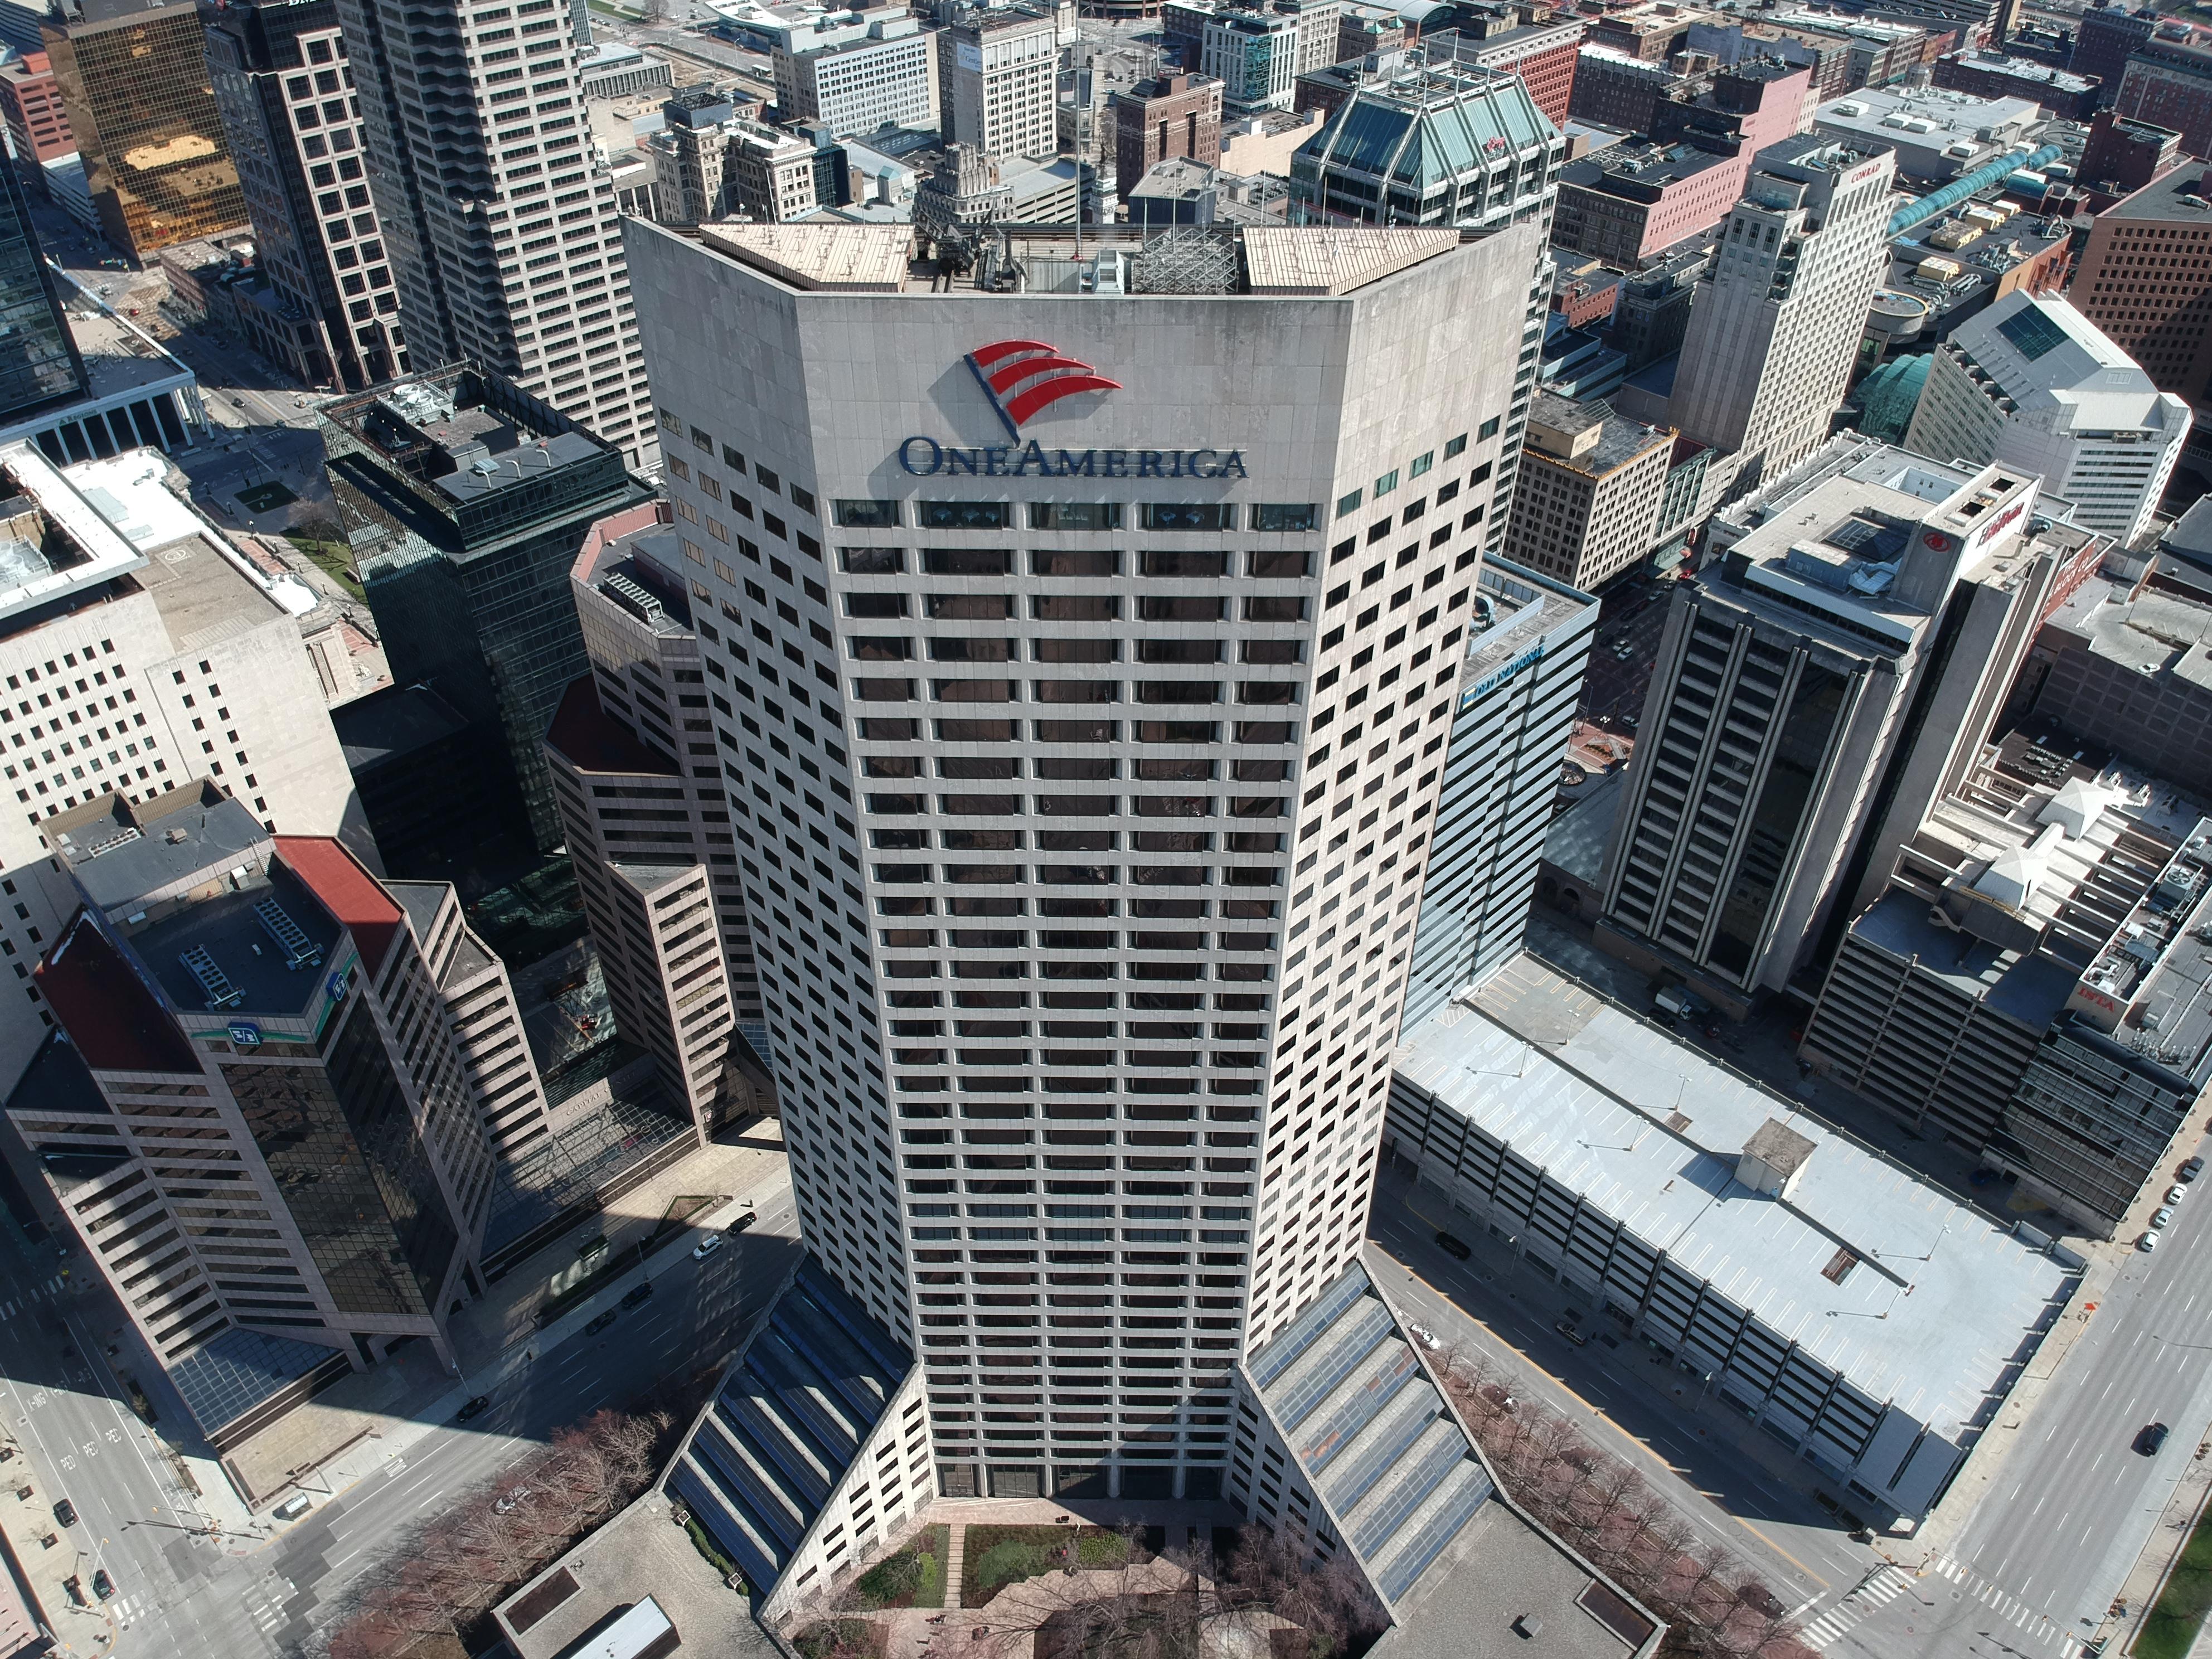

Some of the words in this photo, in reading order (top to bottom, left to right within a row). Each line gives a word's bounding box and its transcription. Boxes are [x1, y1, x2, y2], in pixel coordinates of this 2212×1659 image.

[1851, 163, 1880, 183] CONRAD
[566, 1092, 601, 1116] CAPITAL
[26, 1392, 46, 1412] X-ING
[60, 1455, 76, 1472] PED
[83, 1441, 99, 1457] PED
[105, 1428, 122, 1443] PED
